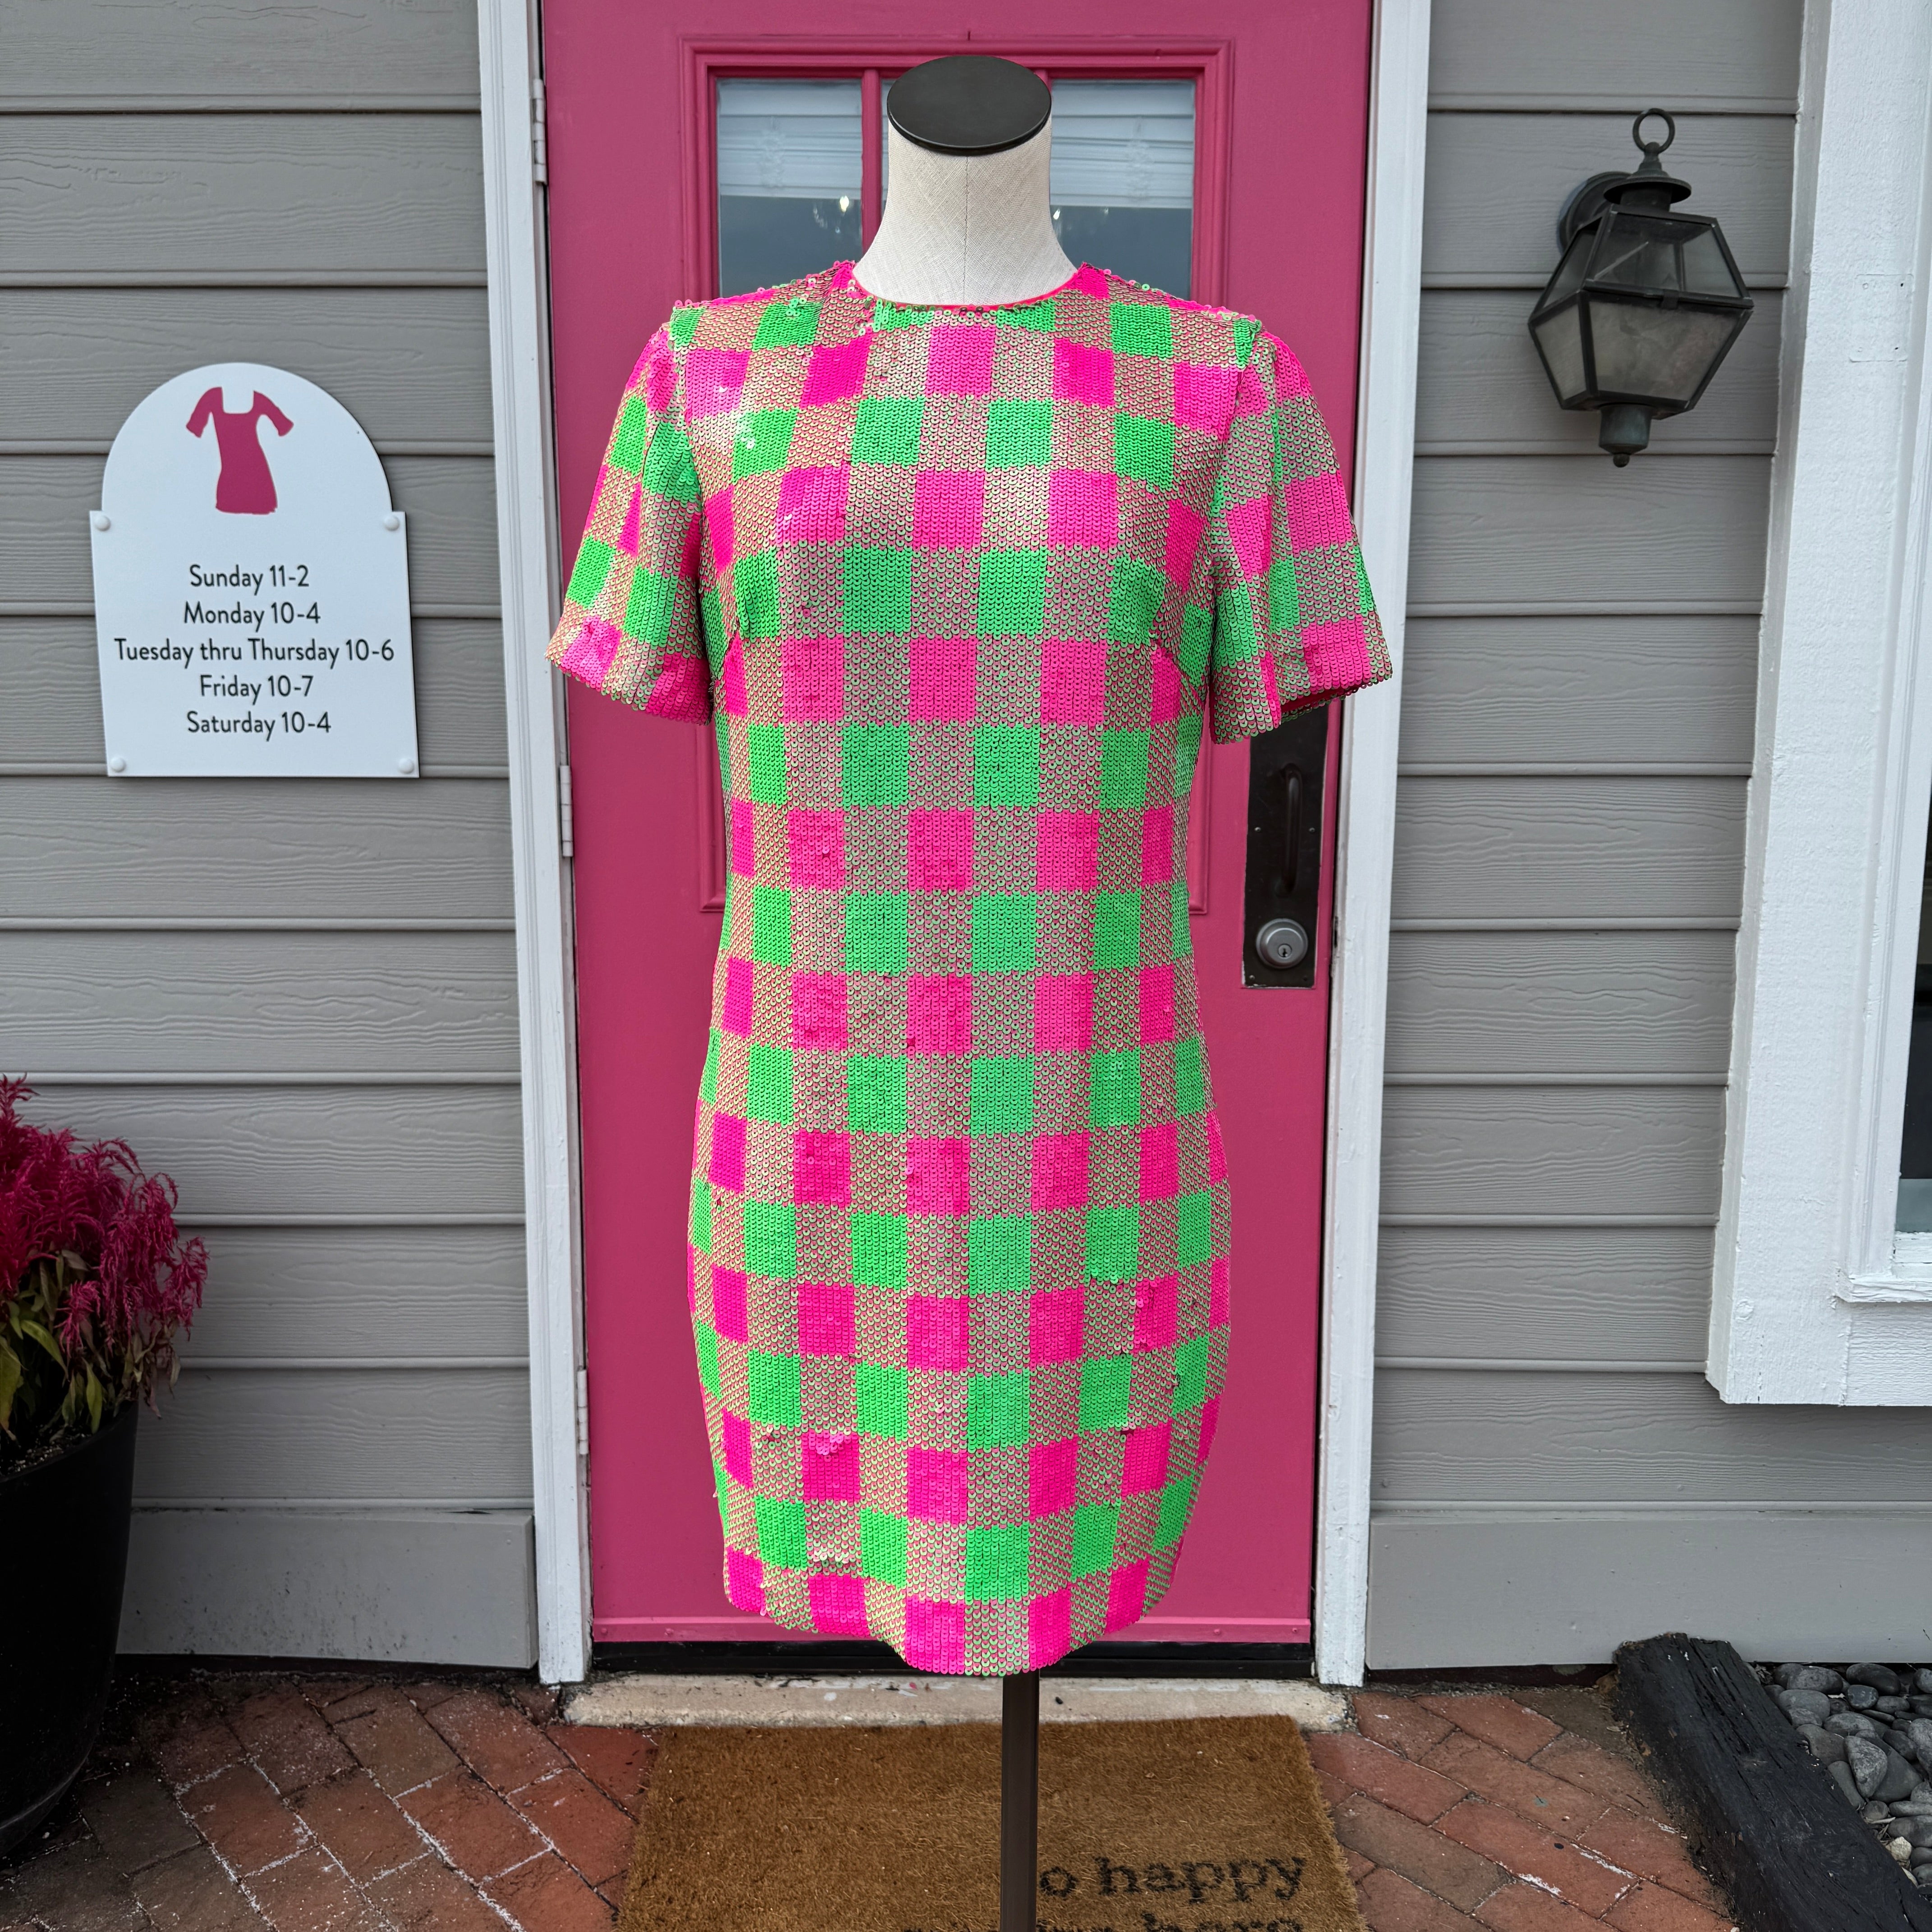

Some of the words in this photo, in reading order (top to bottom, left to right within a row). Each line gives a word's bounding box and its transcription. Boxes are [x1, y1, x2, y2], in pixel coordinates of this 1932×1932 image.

[189, 564, 264, 596] Sunday
[269, 564, 310, 587] 11-2
[183, 601, 265, 633] Monday
[271, 601, 321, 624] 10-4
[114, 638, 194, 670] Tuesday
[200, 638, 242, 661] thru
[247, 638, 340, 670] Thursday
[345, 638, 394, 661] 10-6
[200, 674, 262, 706] Friday
[267, 675, 314, 697] 10-7
[187, 710, 276, 742] Saturday
[281, 711, 331, 733] 10-4
[1039, 1866, 1077, 1896] o
[1093, 1856, 1305, 1904] happy
